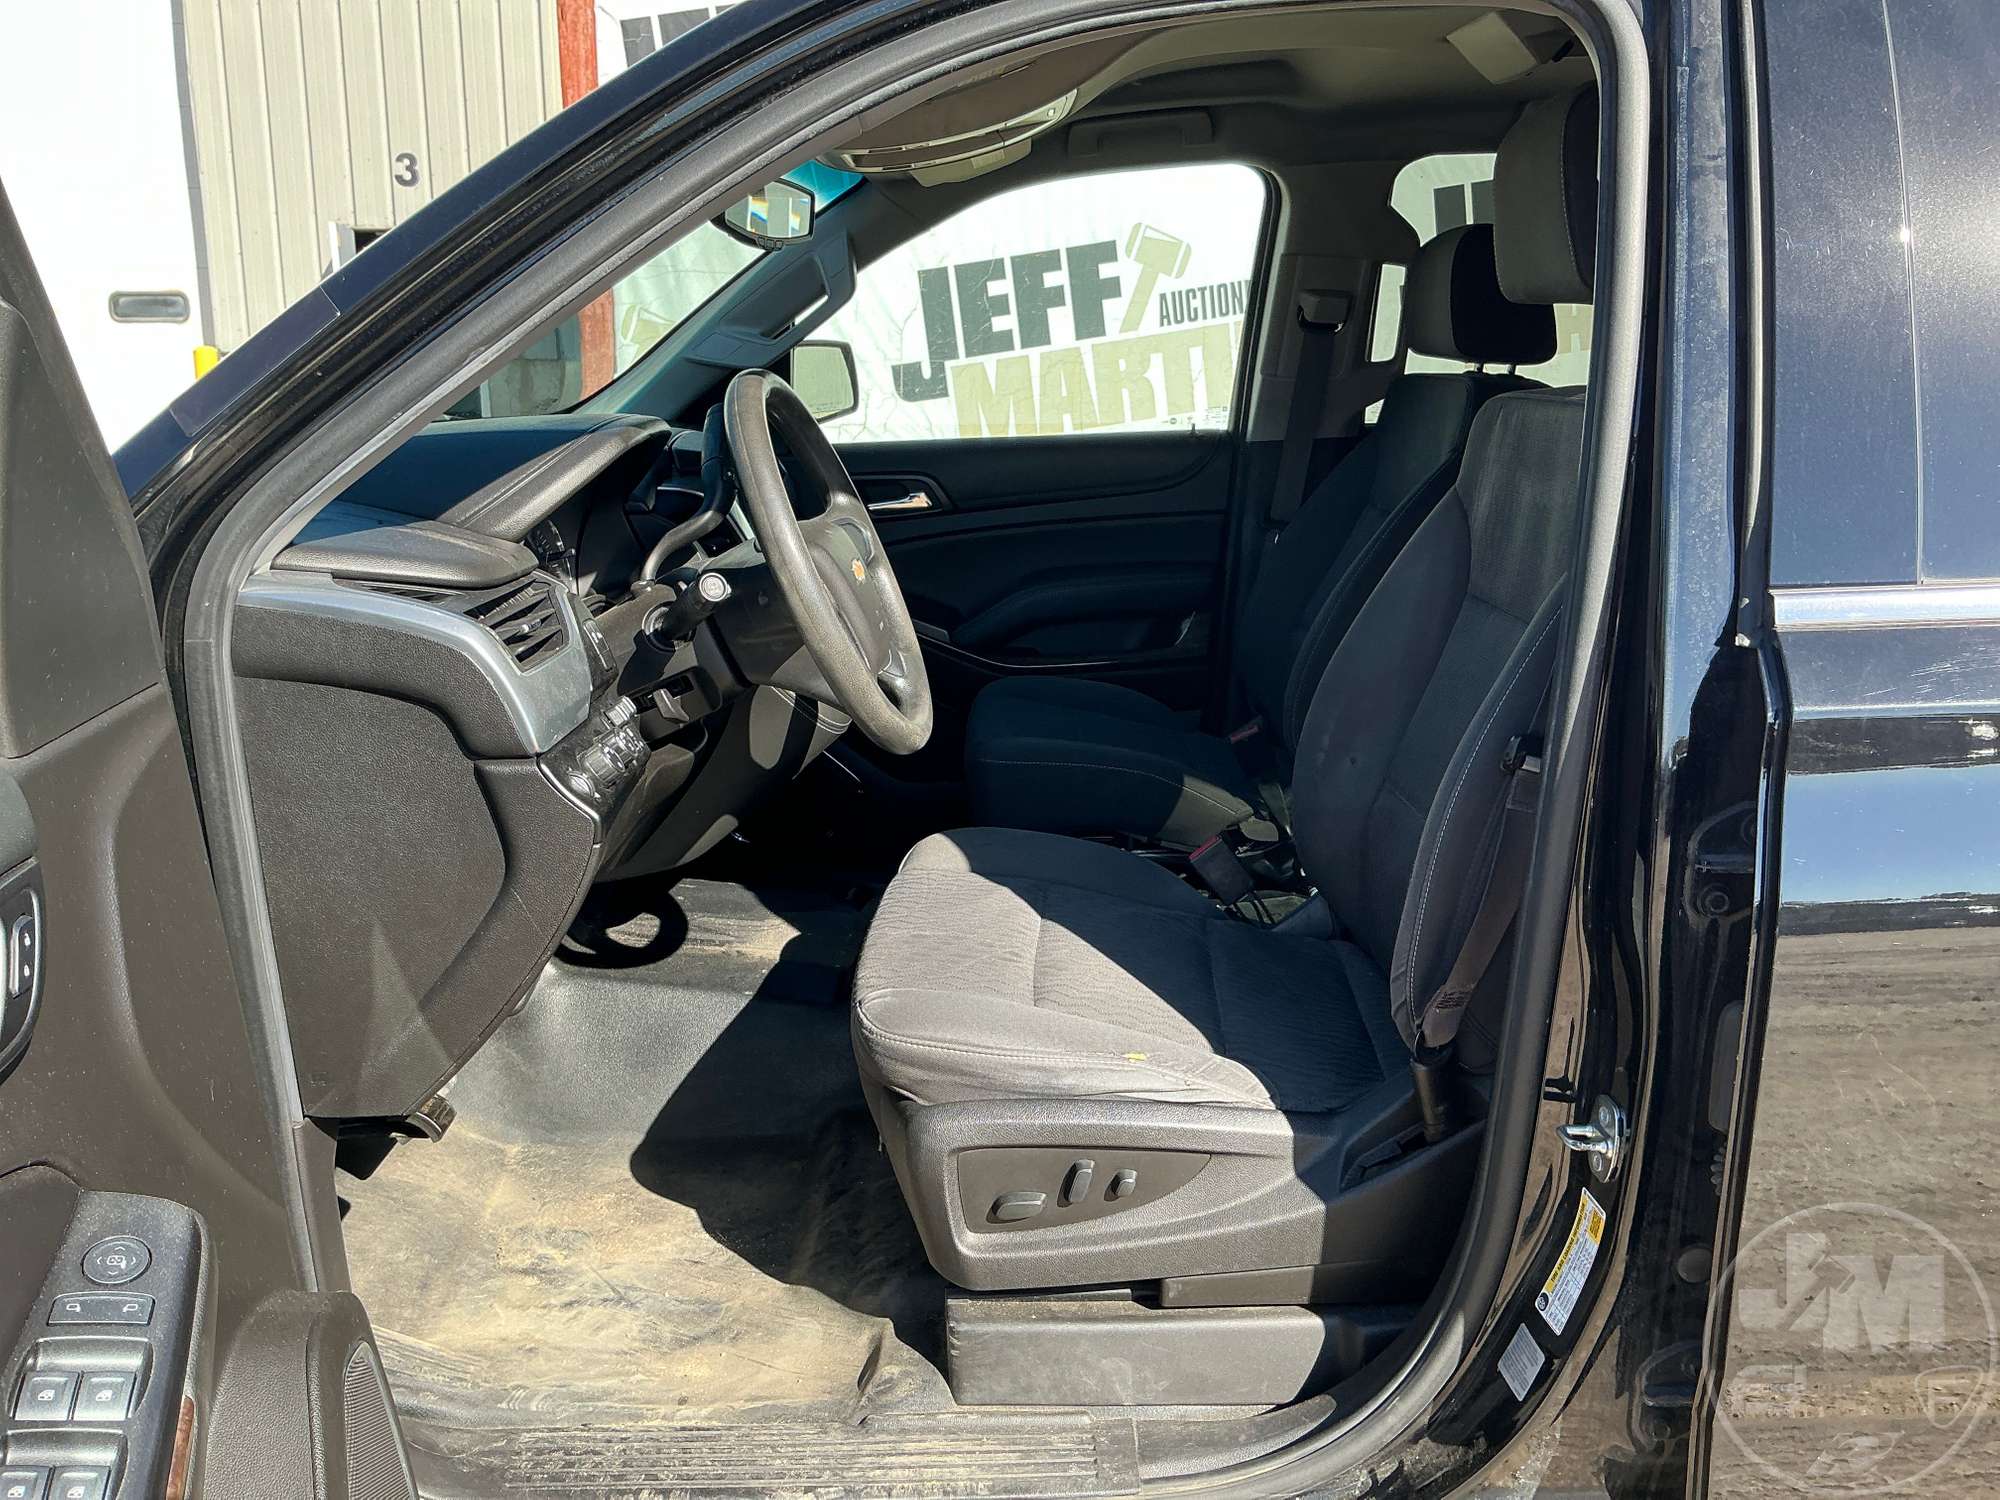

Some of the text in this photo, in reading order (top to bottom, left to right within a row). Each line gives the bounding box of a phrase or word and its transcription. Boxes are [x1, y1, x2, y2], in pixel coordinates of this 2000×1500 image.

[395, 152, 419, 187] 3
[891, 239, 1122, 403] JEFF
[950, 319, 1243, 437] MARTI
